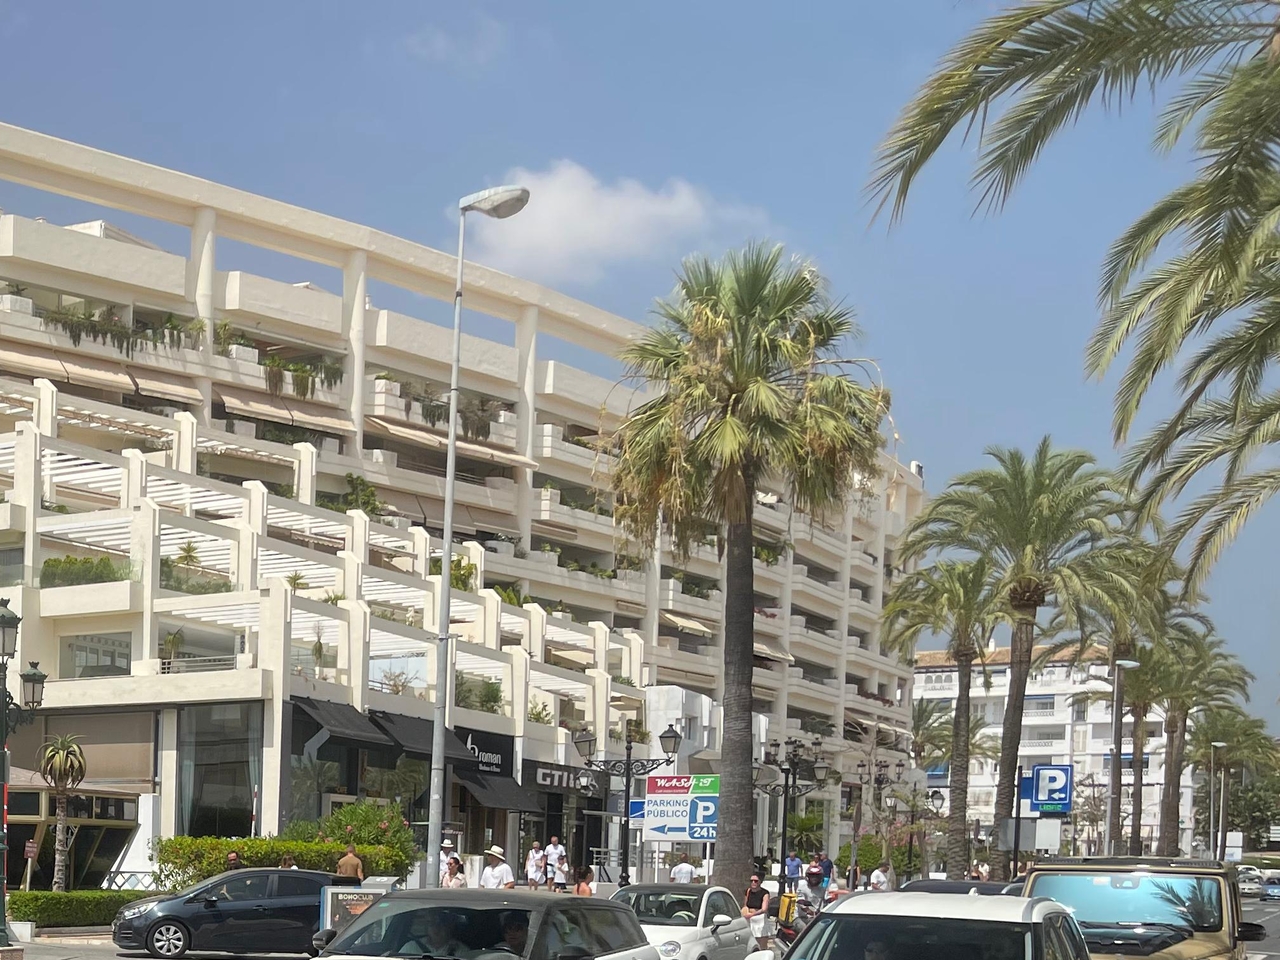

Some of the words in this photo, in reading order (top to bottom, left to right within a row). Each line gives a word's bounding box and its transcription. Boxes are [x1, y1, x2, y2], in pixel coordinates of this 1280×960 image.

[478, 751, 502, 765] roman
[655, 777, 699, 788] WASH
[1038, 770, 1066, 800] P
[646, 799, 689, 807] PARKING
[646, 808, 689, 818] PÚBLICO
[696, 801, 716, 824] P
